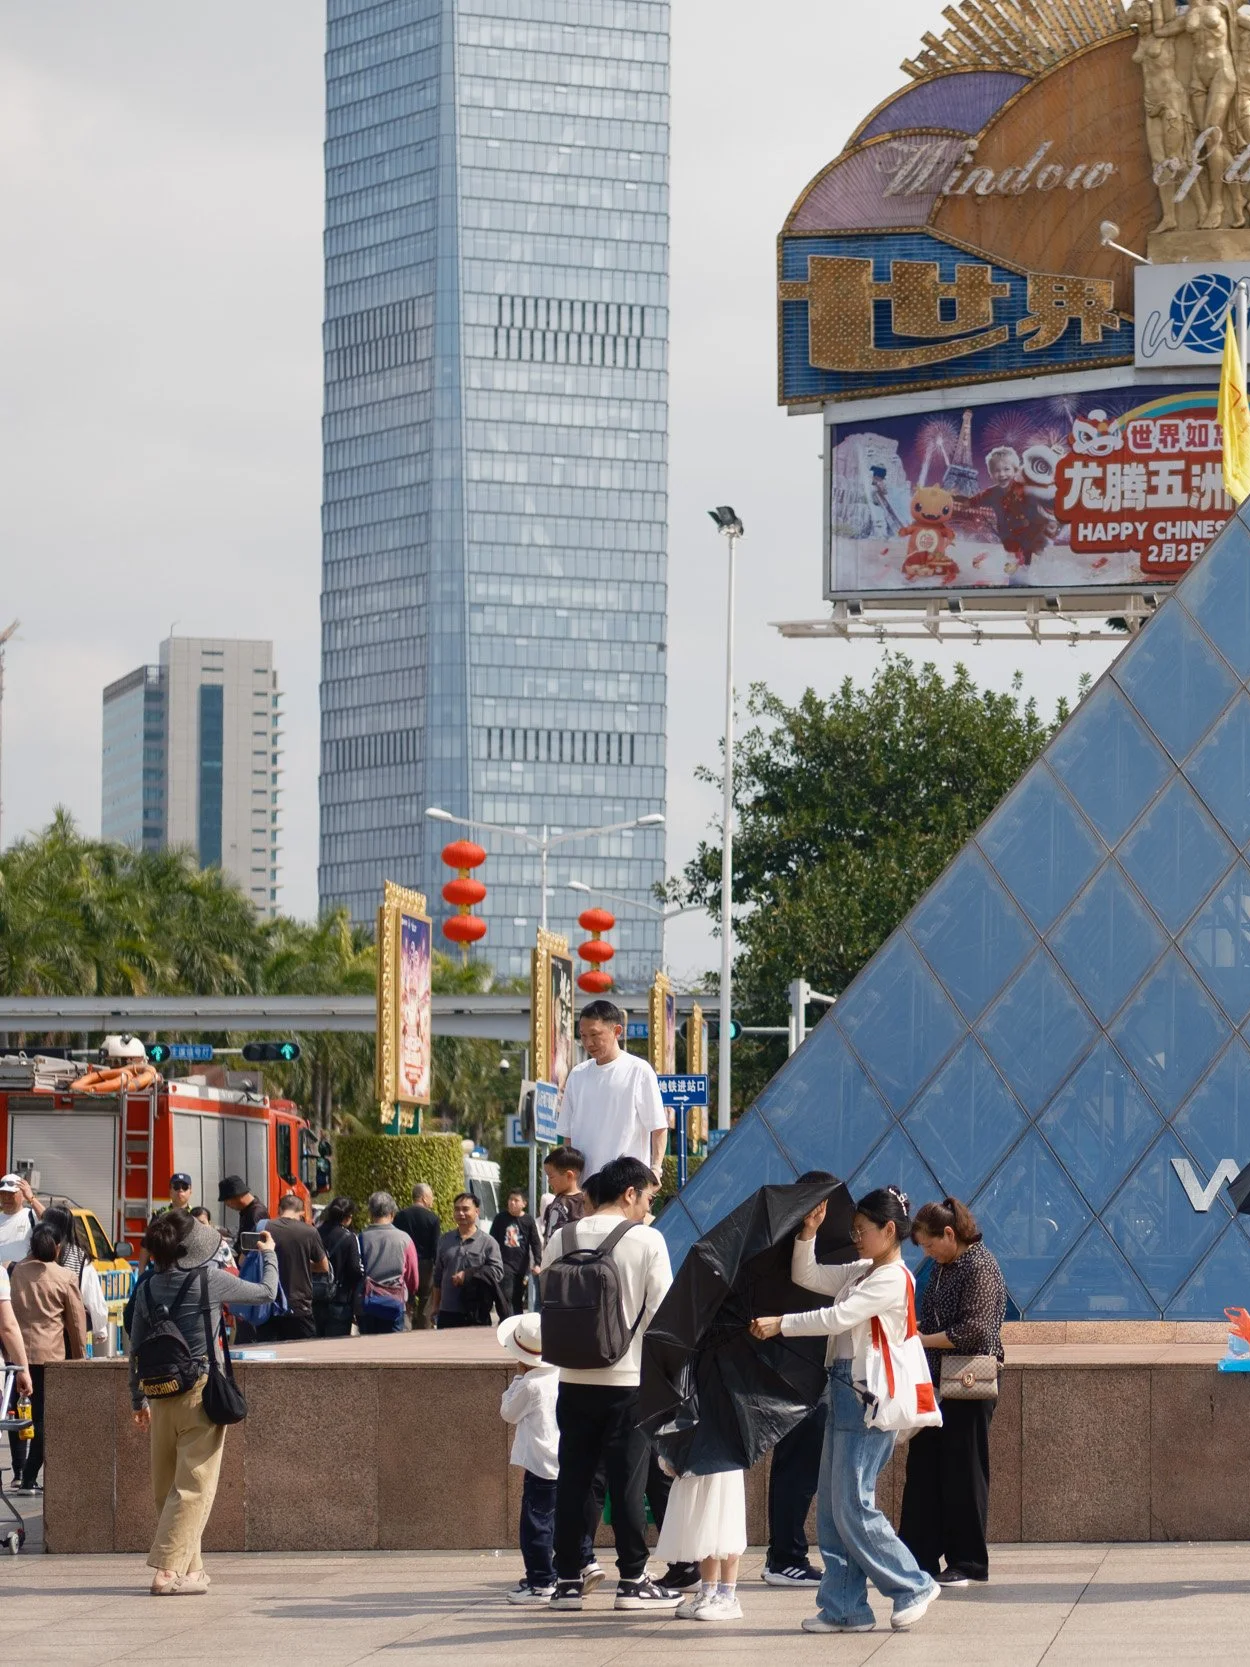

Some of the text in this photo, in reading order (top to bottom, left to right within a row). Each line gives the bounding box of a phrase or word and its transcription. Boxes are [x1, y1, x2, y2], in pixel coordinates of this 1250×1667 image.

[876, 139, 1118, 199] Window
[1151, 125, 1224, 202] of
[1077, 521, 1150, 542] HAPPY
